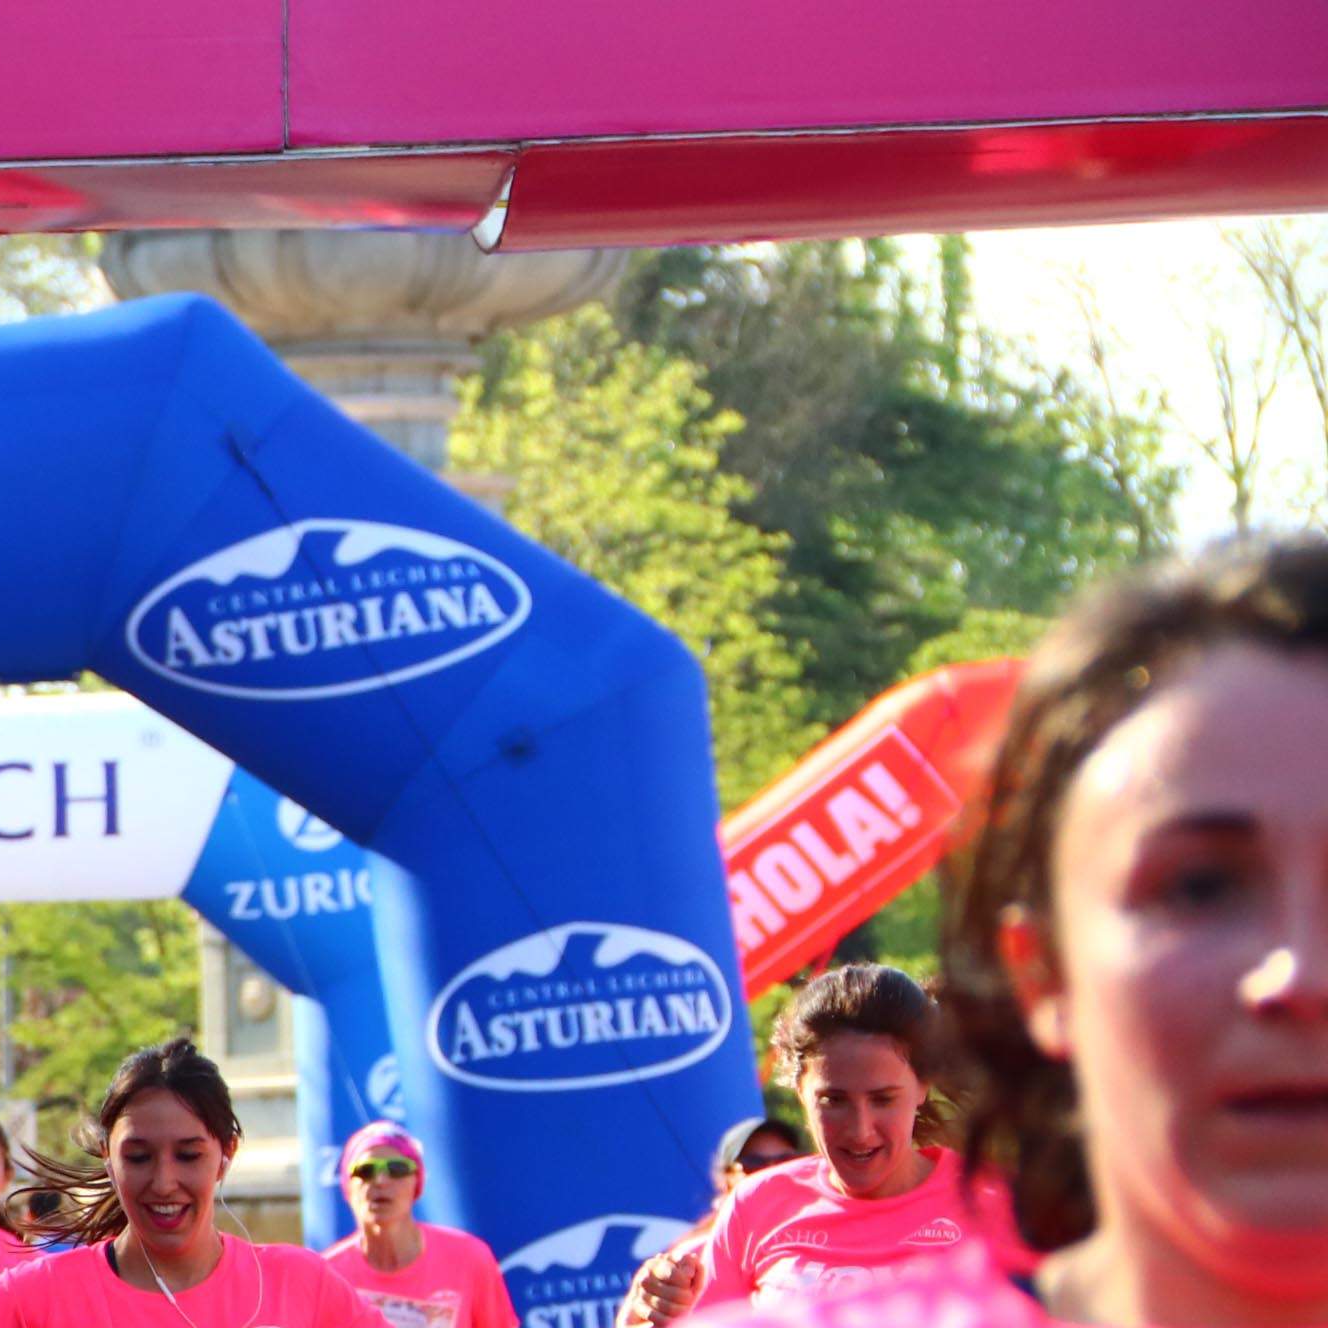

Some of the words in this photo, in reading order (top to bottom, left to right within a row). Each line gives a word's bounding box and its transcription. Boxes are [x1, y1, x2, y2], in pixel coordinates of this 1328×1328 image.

[350, 560, 482, 597] LECHERA
[164, 581, 505, 669] ASTURIANA
[223, 867, 375, 921] ZURIC
[450, 986, 718, 1064] ASTURIANA
[524, 1271, 632, 1300] CENTRA
